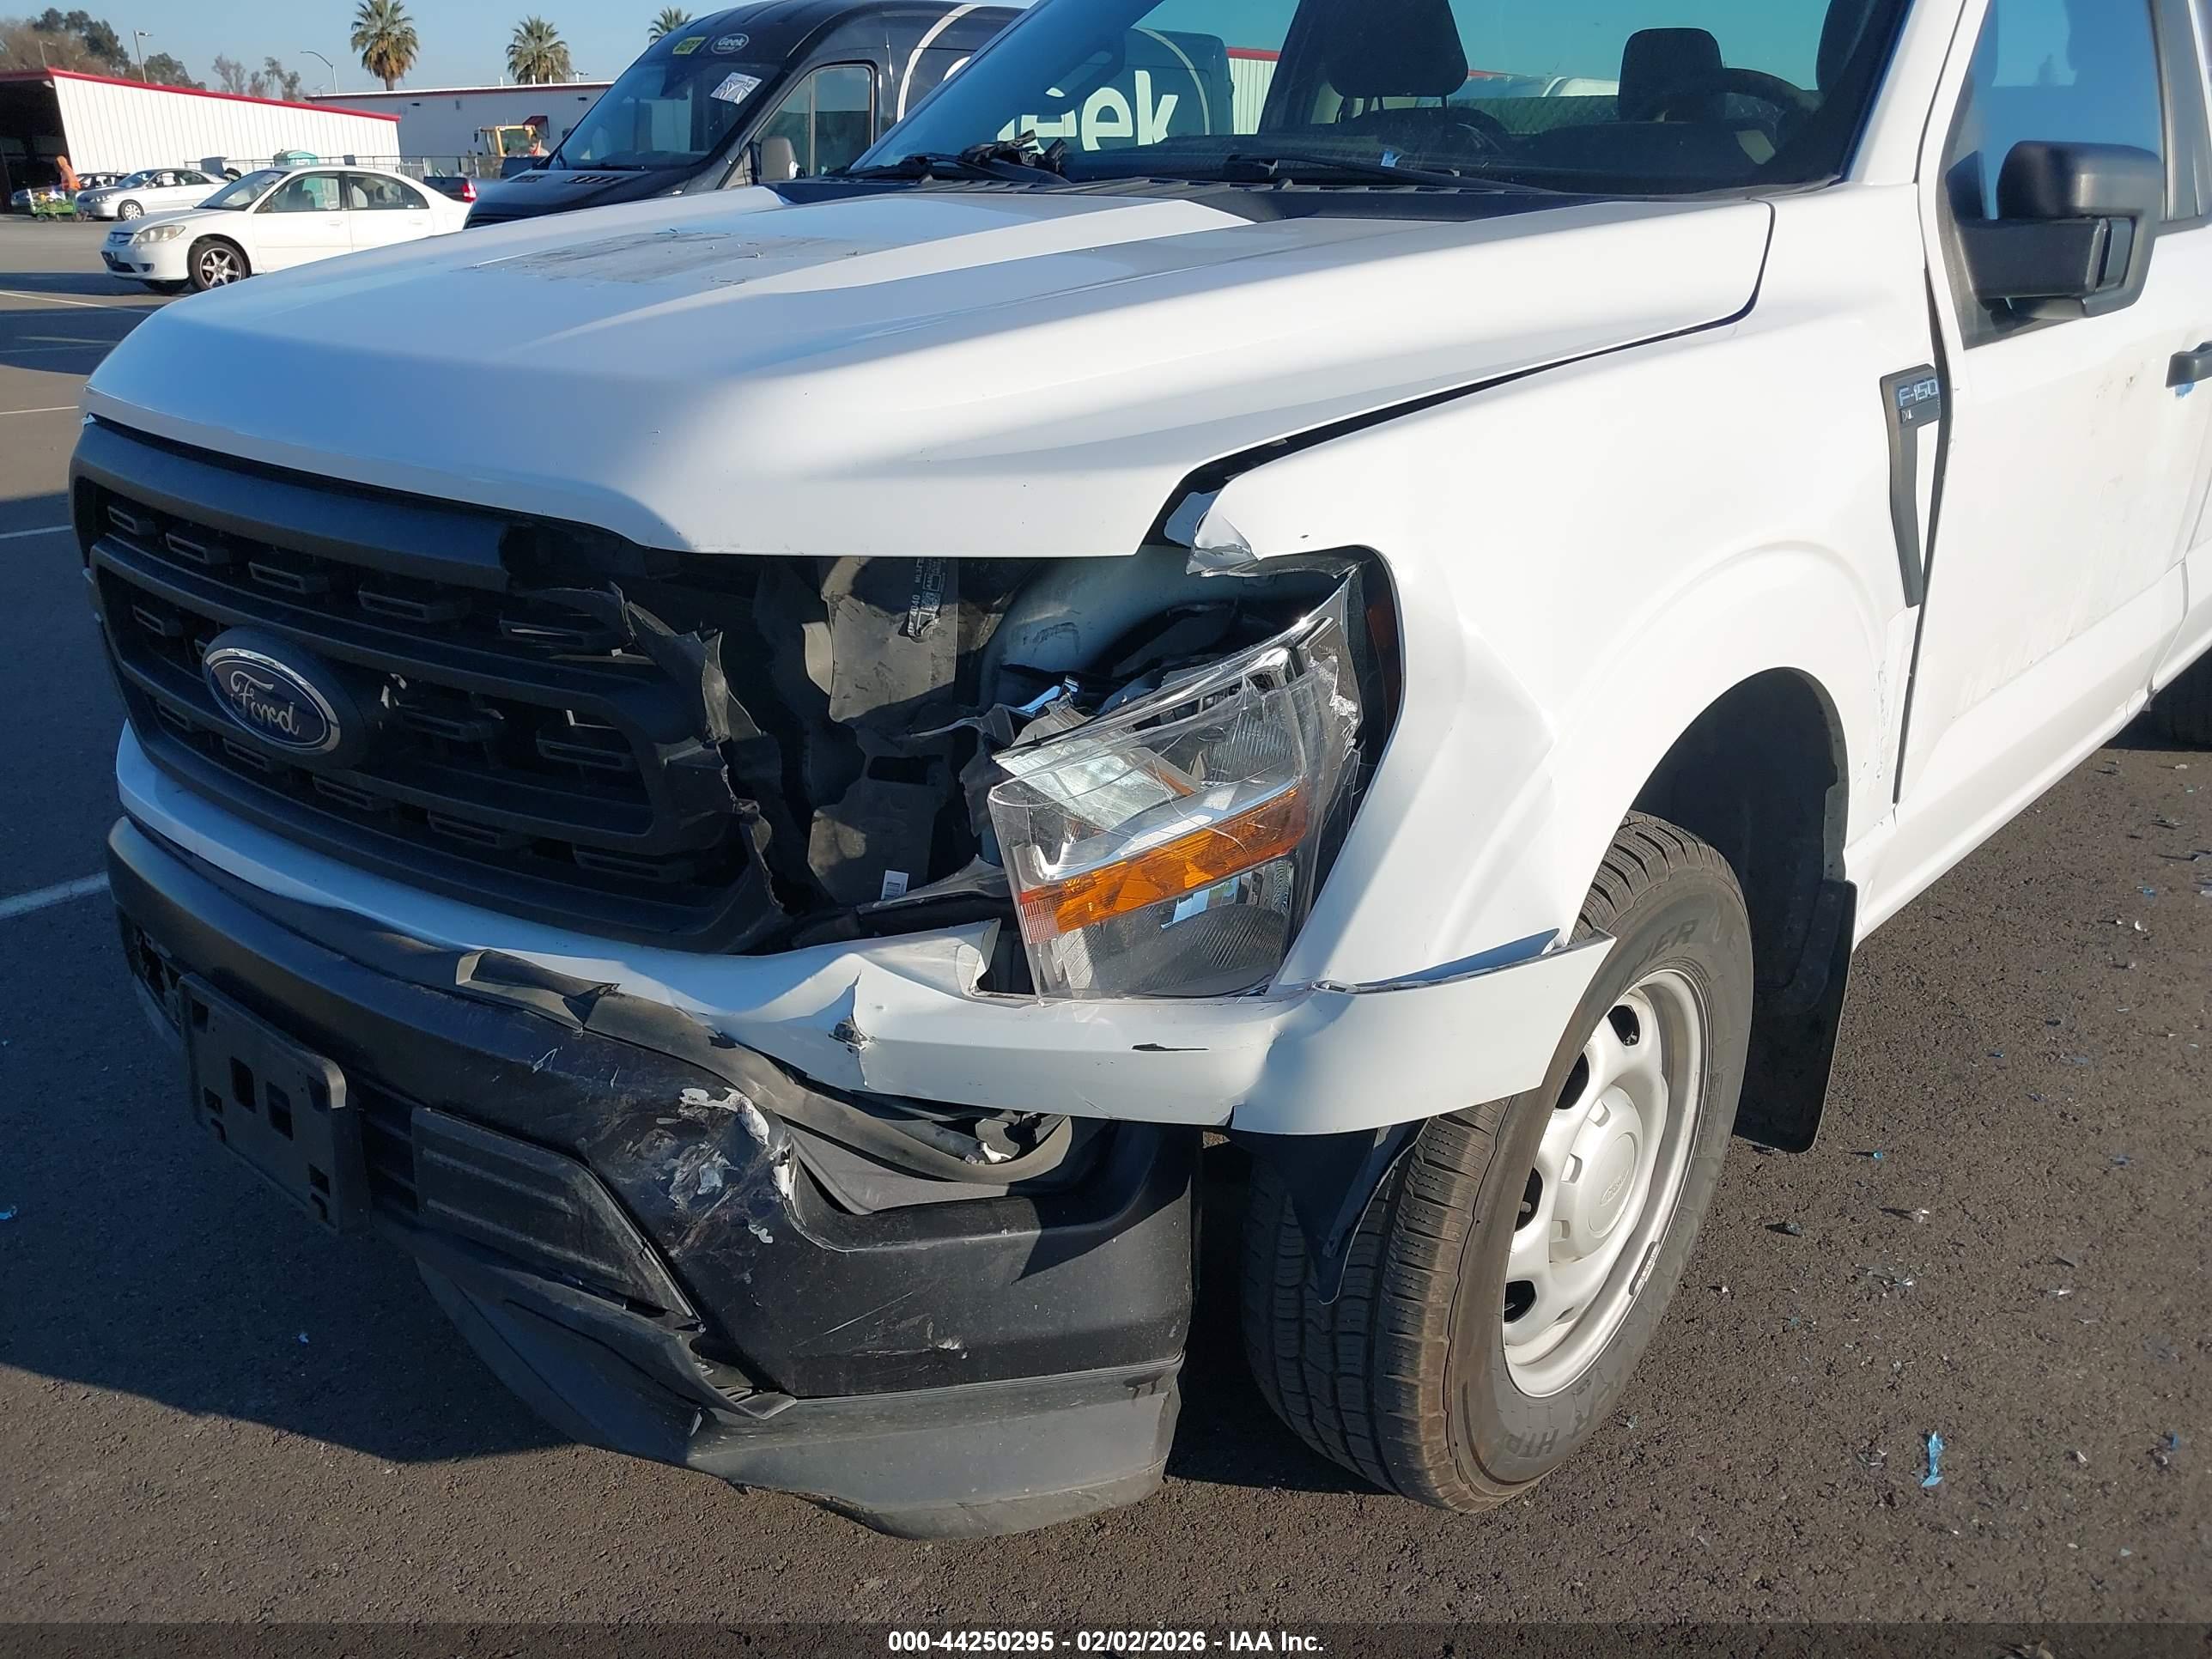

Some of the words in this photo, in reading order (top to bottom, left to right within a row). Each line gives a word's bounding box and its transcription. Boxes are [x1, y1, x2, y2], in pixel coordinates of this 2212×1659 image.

[718, 37, 745, 46] Geek
[1899, 380, 1940, 406] F-150
[230, 670, 301, 736] Ford
